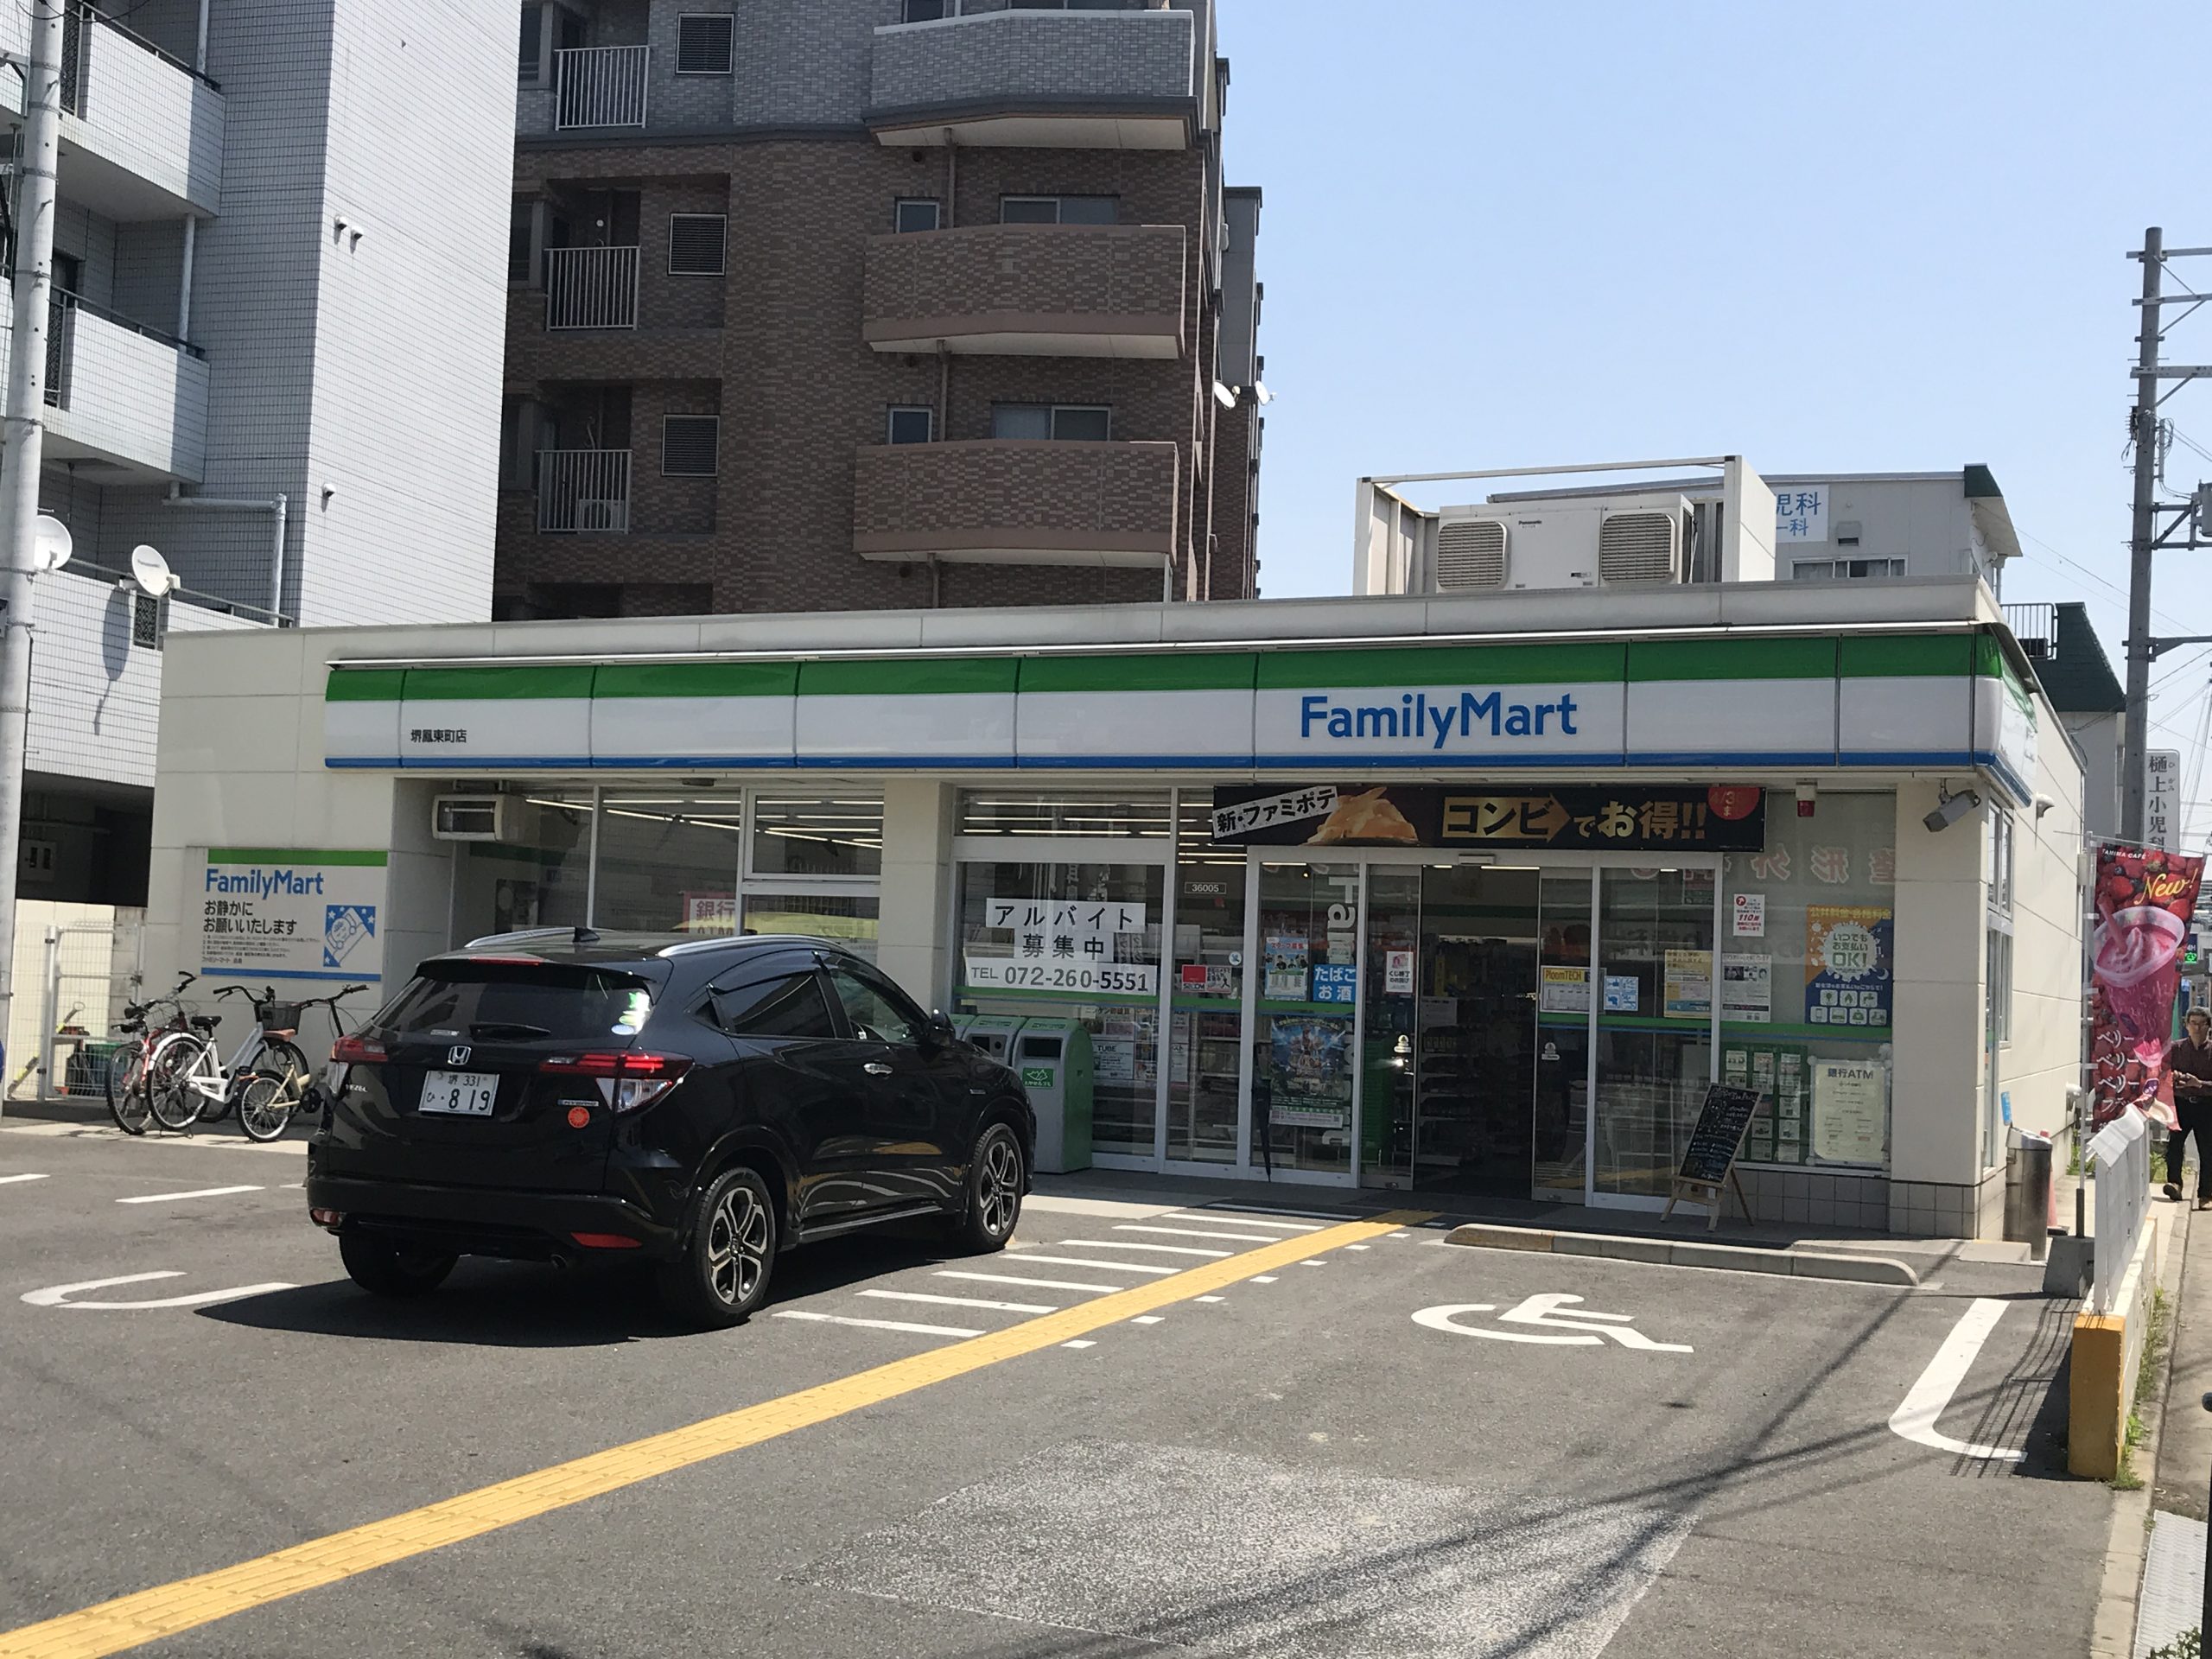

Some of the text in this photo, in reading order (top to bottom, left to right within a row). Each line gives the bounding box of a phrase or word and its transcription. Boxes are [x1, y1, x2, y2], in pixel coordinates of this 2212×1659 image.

[1301, 691, 1578, 749] FamilyMart
[206, 868, 324, 899] FamilyMart
[1192, 884, 1219, 893] 36005
[2133, 868, 2198, 906] New!
[204, 899, 253, 916] お静かに
[696, 900, 734, 923] 銀行
[995, 905, 1133, 930] アルバイト
[203, 918, 297, 935] お願いいたします
[1022, 933, 1104, 961] 募集中
[1833, 952, 1867, 967] OK!
[971, 966, 1148, 992] TEL 072-260-5551
[1314, 967, 1356, 982] たばこ
[1318, 985, 1352, 1001] お酒
[2096, 1029, 2135, 1049] ベリー
[2096, 1052, 2139, 1071] ベリー
[2098, 1073, 2140, 1094] ベリー
